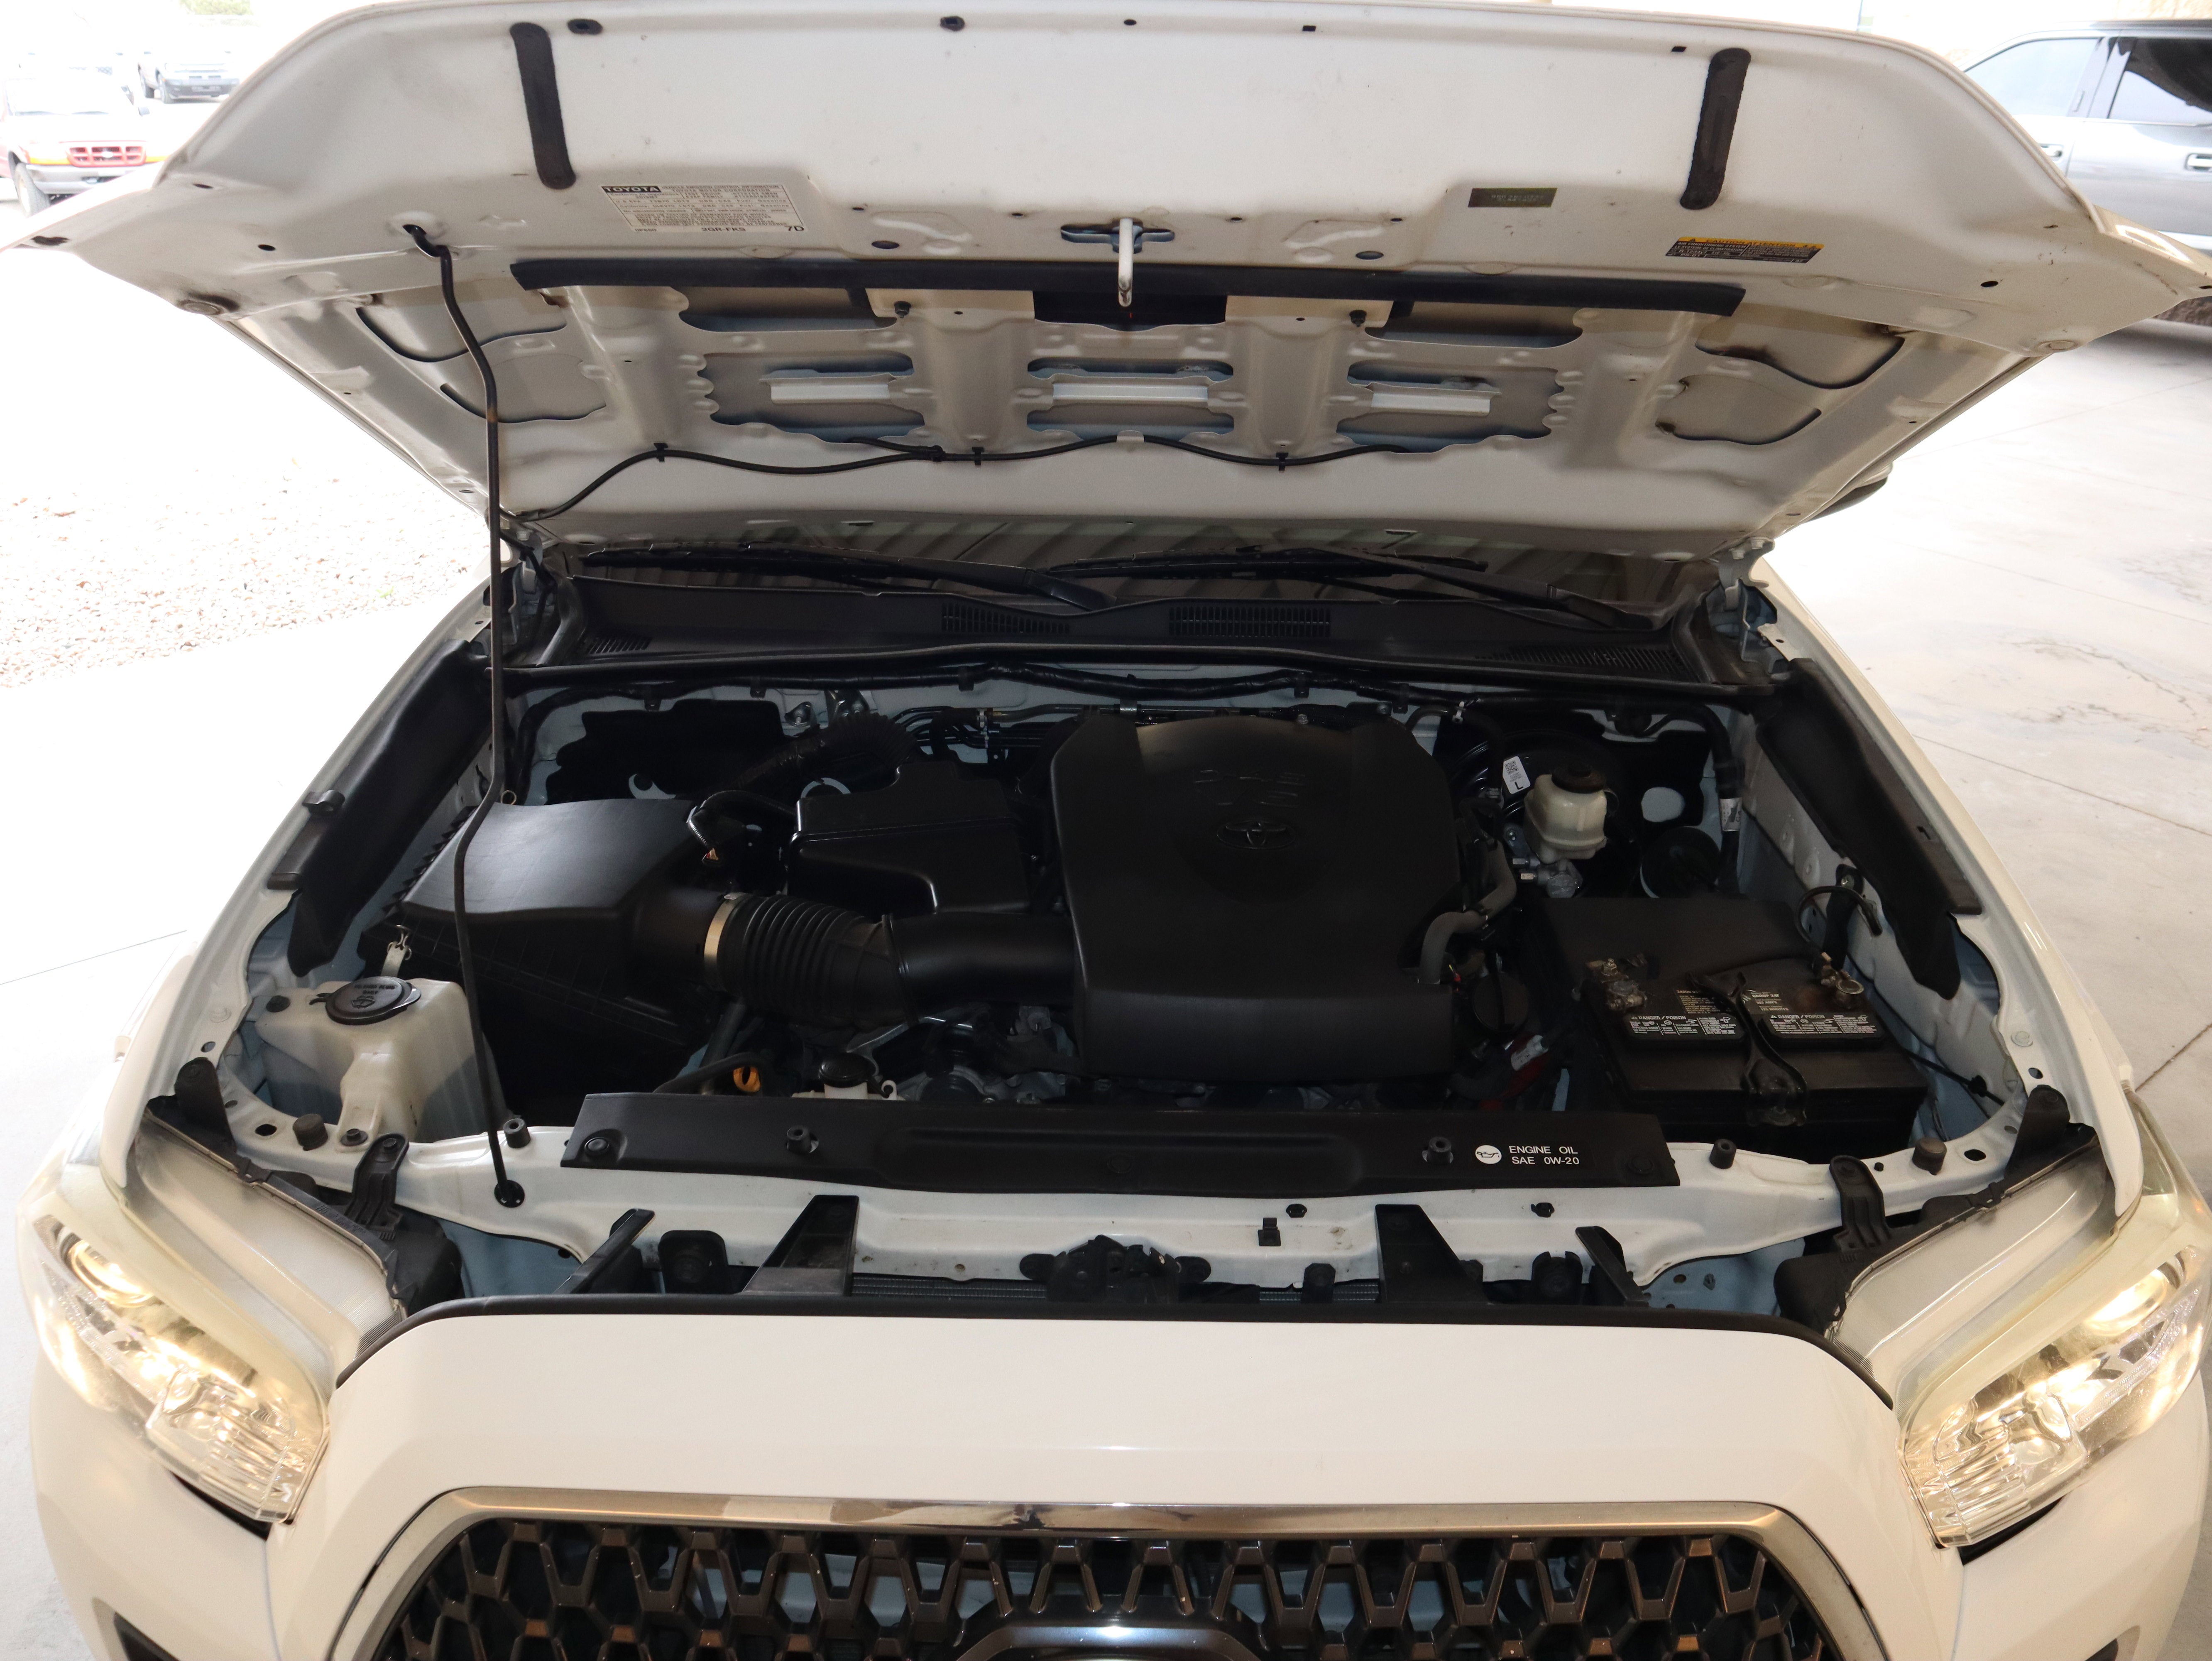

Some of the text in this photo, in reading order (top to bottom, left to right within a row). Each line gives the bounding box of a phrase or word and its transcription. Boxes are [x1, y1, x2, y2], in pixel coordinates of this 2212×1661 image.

[1515, 782, 1523, 790] L
[1509, 1145, 1578, 1154] ENGINE OIL
[1512, 1156, 1580, 1165] SAE 0W-20
